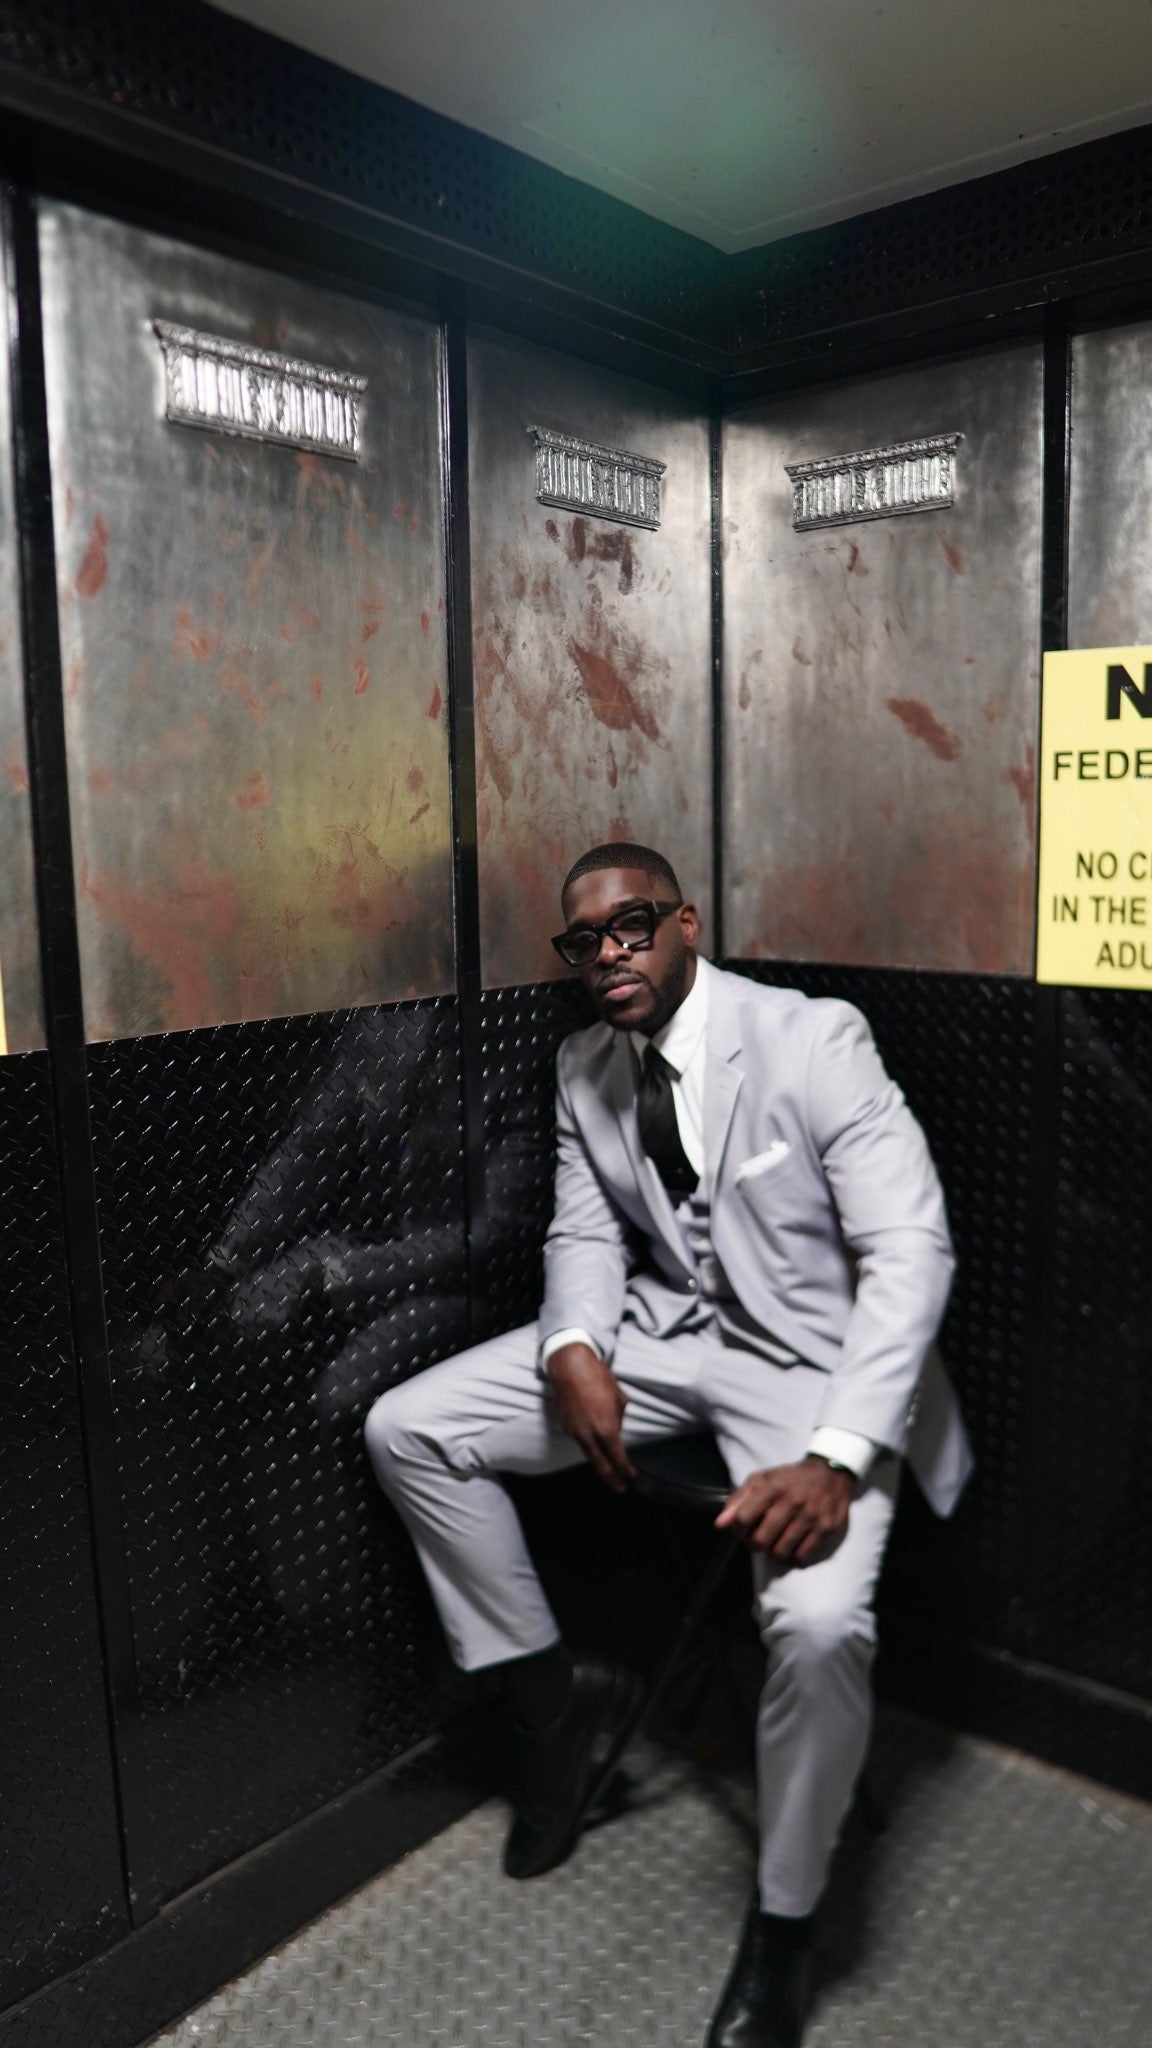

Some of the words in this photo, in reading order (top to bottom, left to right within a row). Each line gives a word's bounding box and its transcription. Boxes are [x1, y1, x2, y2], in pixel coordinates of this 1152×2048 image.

[1053, 749, 1152, 780] FEDE
[1076, 851, 1118, 880] NO
[1052, 895, 1078, 922] IN
[1090, 895, 1146, 925] THE
